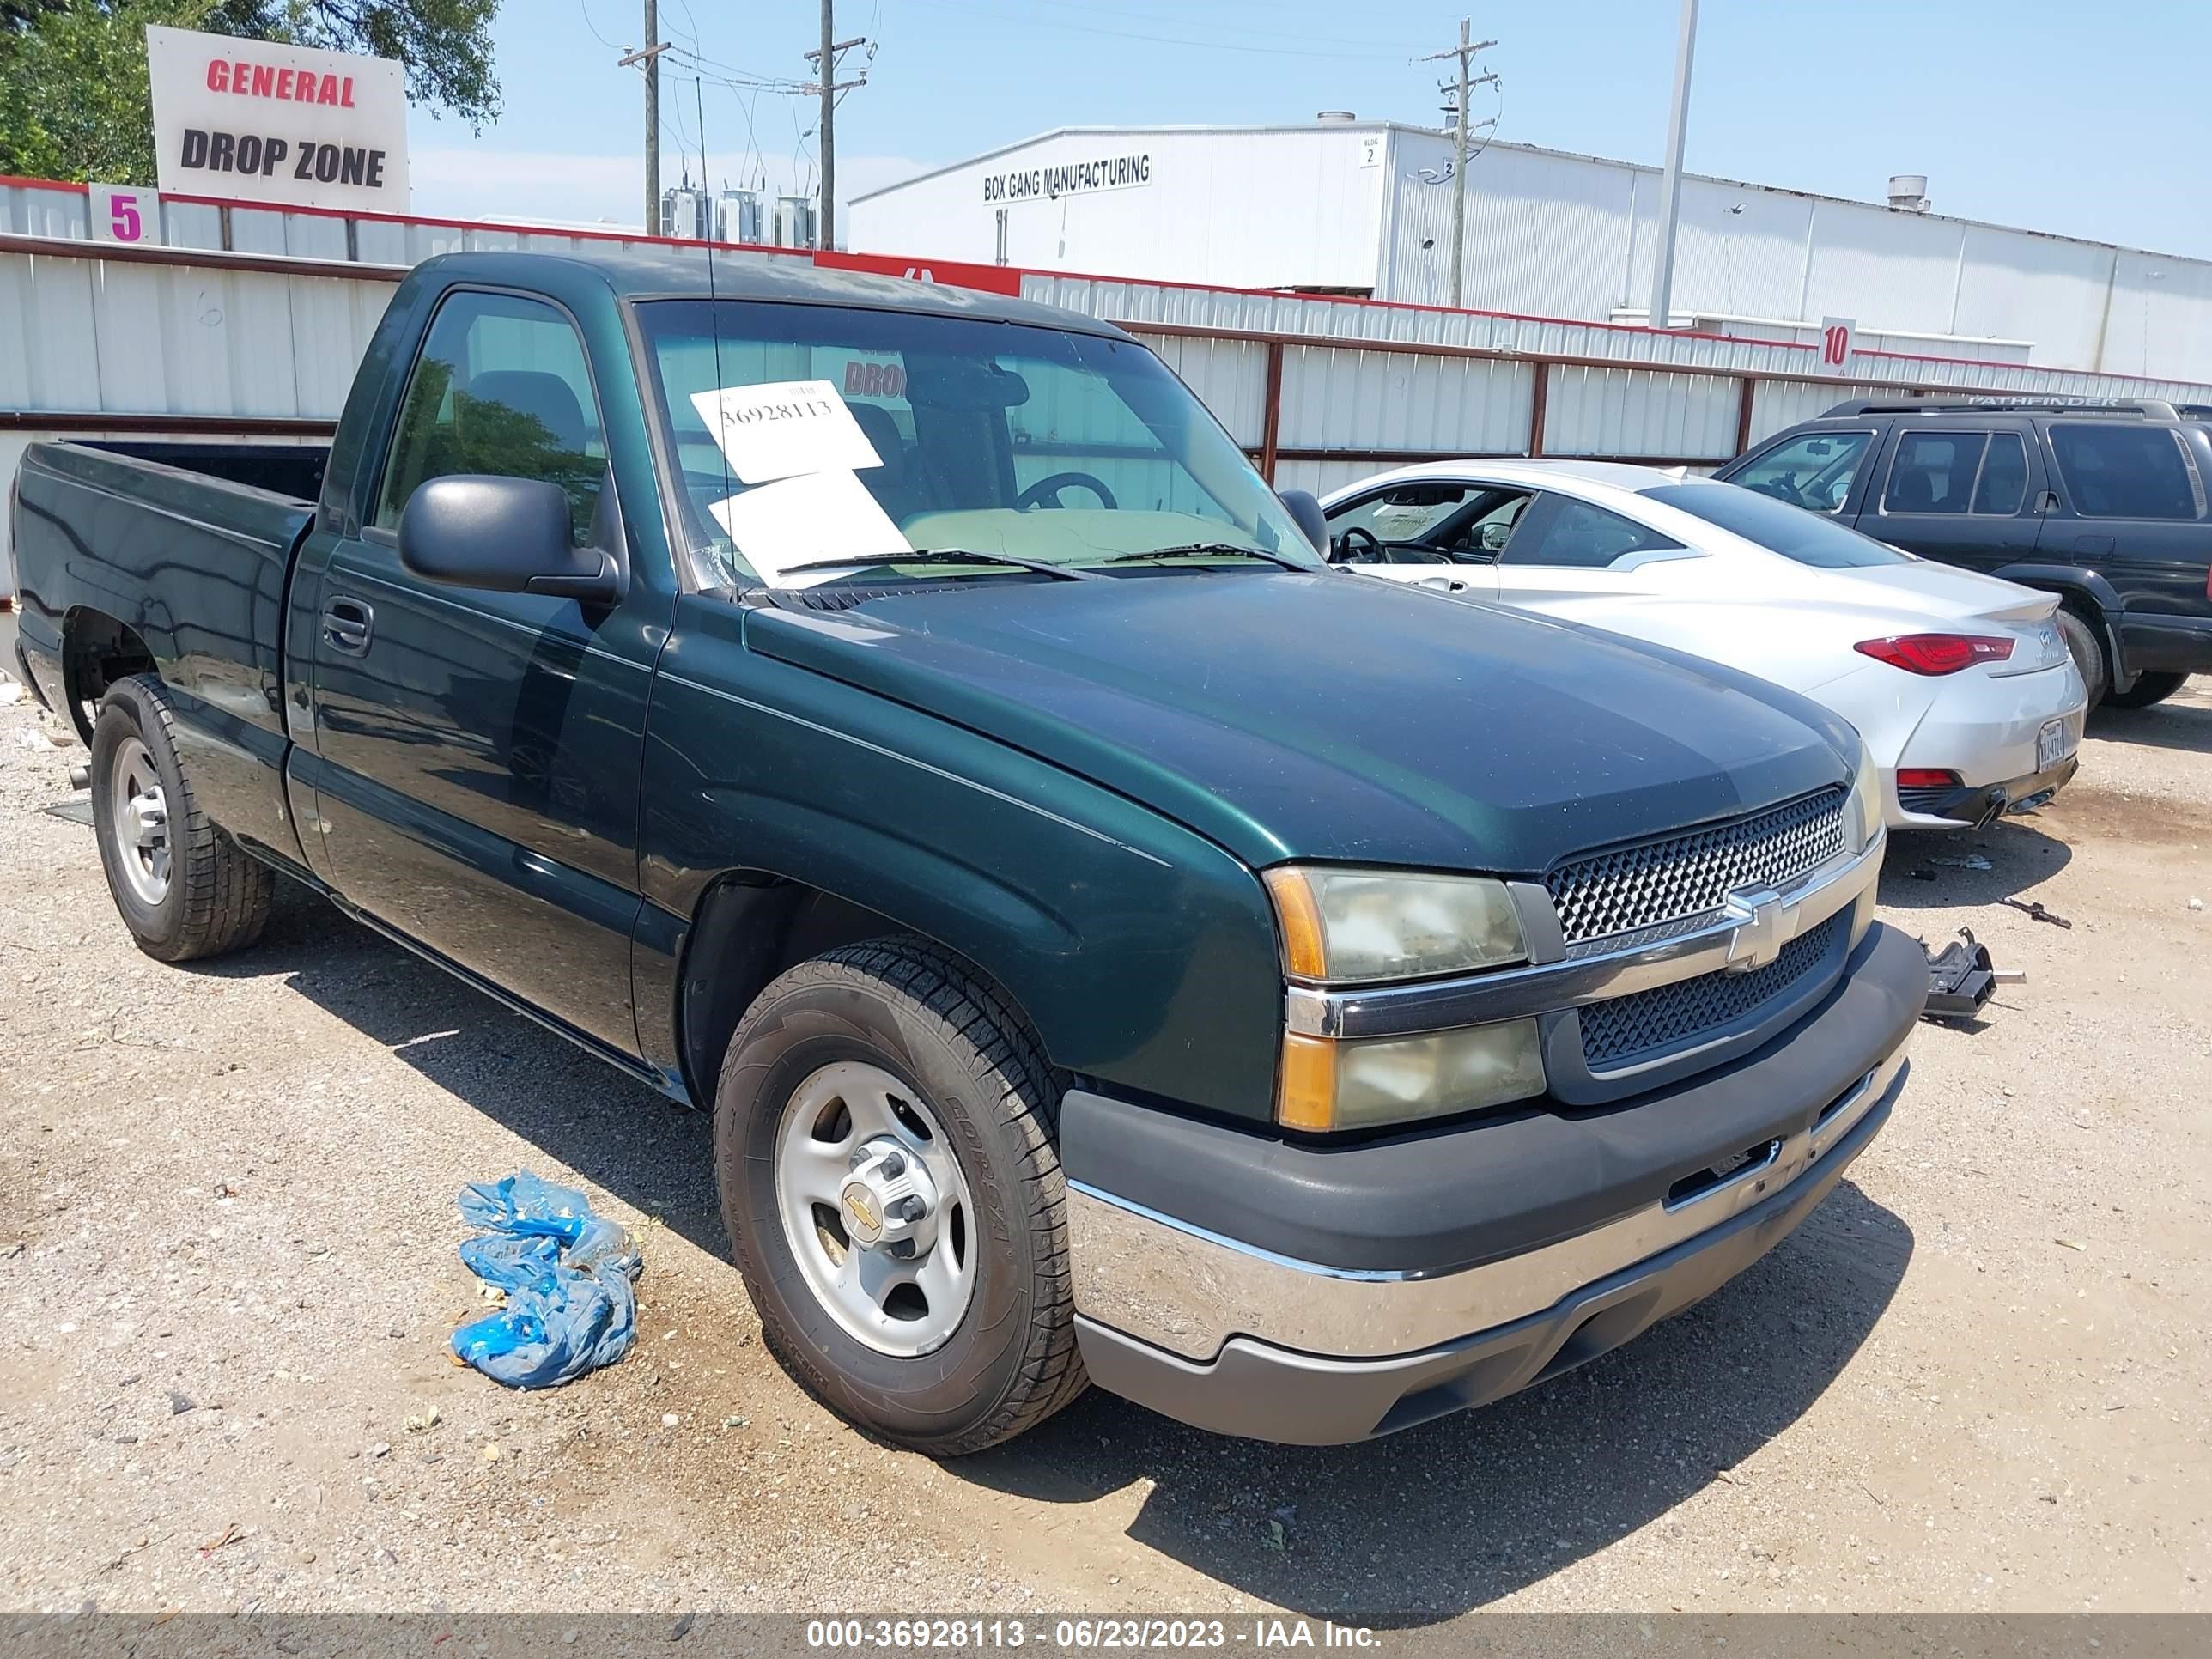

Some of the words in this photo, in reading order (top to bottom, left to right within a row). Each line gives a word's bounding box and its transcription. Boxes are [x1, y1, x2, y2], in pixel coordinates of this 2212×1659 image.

[206, 59, 356, 109] GENERAL
[180, 128, 289, 177] DROP
[294, 142, 386, 188] ZONE
[1367, 149, 1374, 162] 2
[1446, 163, 1453, 174] 2
[984, 174, 1006, 201] BOX
[1009, 170, 1040, 198] GANG
[1043, 154, 1150, 195] MANUFACTURING
[111, 195, 141, 241] 5
[1825, 326, 1849, 365] 10
[721, 400, 832, 428] 36928113
[1968, 397, 2119, 407] PATHFINDER
